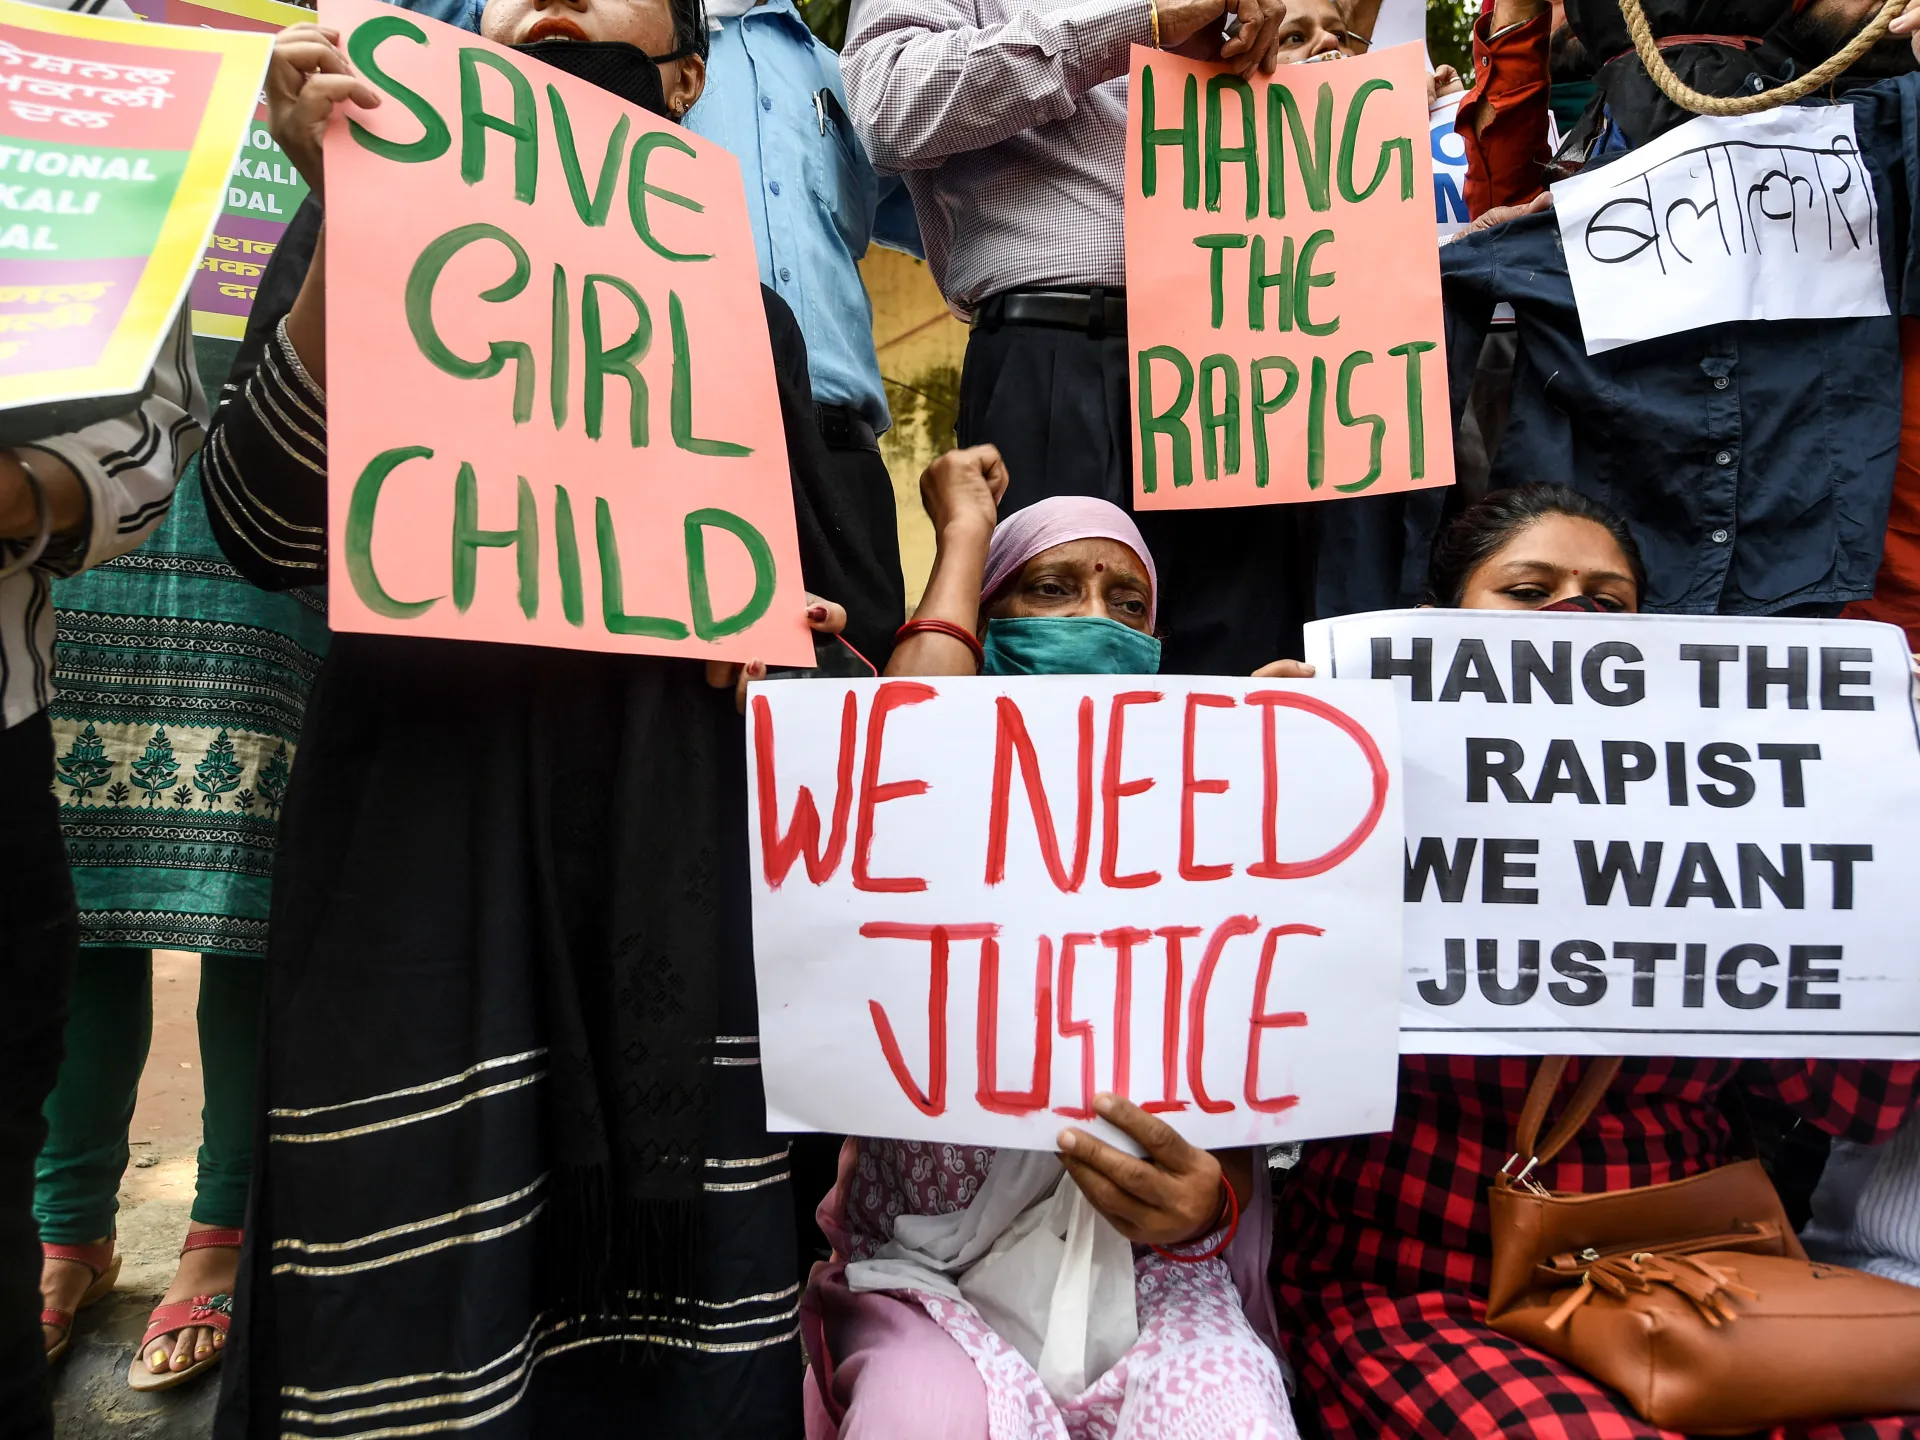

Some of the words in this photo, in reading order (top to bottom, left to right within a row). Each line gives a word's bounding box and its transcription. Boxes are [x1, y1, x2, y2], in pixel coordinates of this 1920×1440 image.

[228, 187, 283, 214] DAL
[347, 16, 716, 262] SAVE
[1141, 65, 1414, 221] HANG
[0, 223, 59, 250] AL
[1193, 229, 1341, 336] THE
[405, 223, 755, 456] GIRL
[1138, 341, 1437, 493] RAPIST
[345, 446, 776, 643] CHILD
[1371, 637, 1645, 706] HANG
[1680, 643, 1875, 711] THE
[751, 681, 939, 893] WE
[984, 689, 1389, 893] NEED
[1466, 737, 1821, 808] RAPIST
[1403, 836, 1539, 904] WE
[1573, 840, 1873, 909] WANT
[859, 914, 1326, 1119] JUSTICE
[1416, 938, 1843, 1009] JUSTICE
